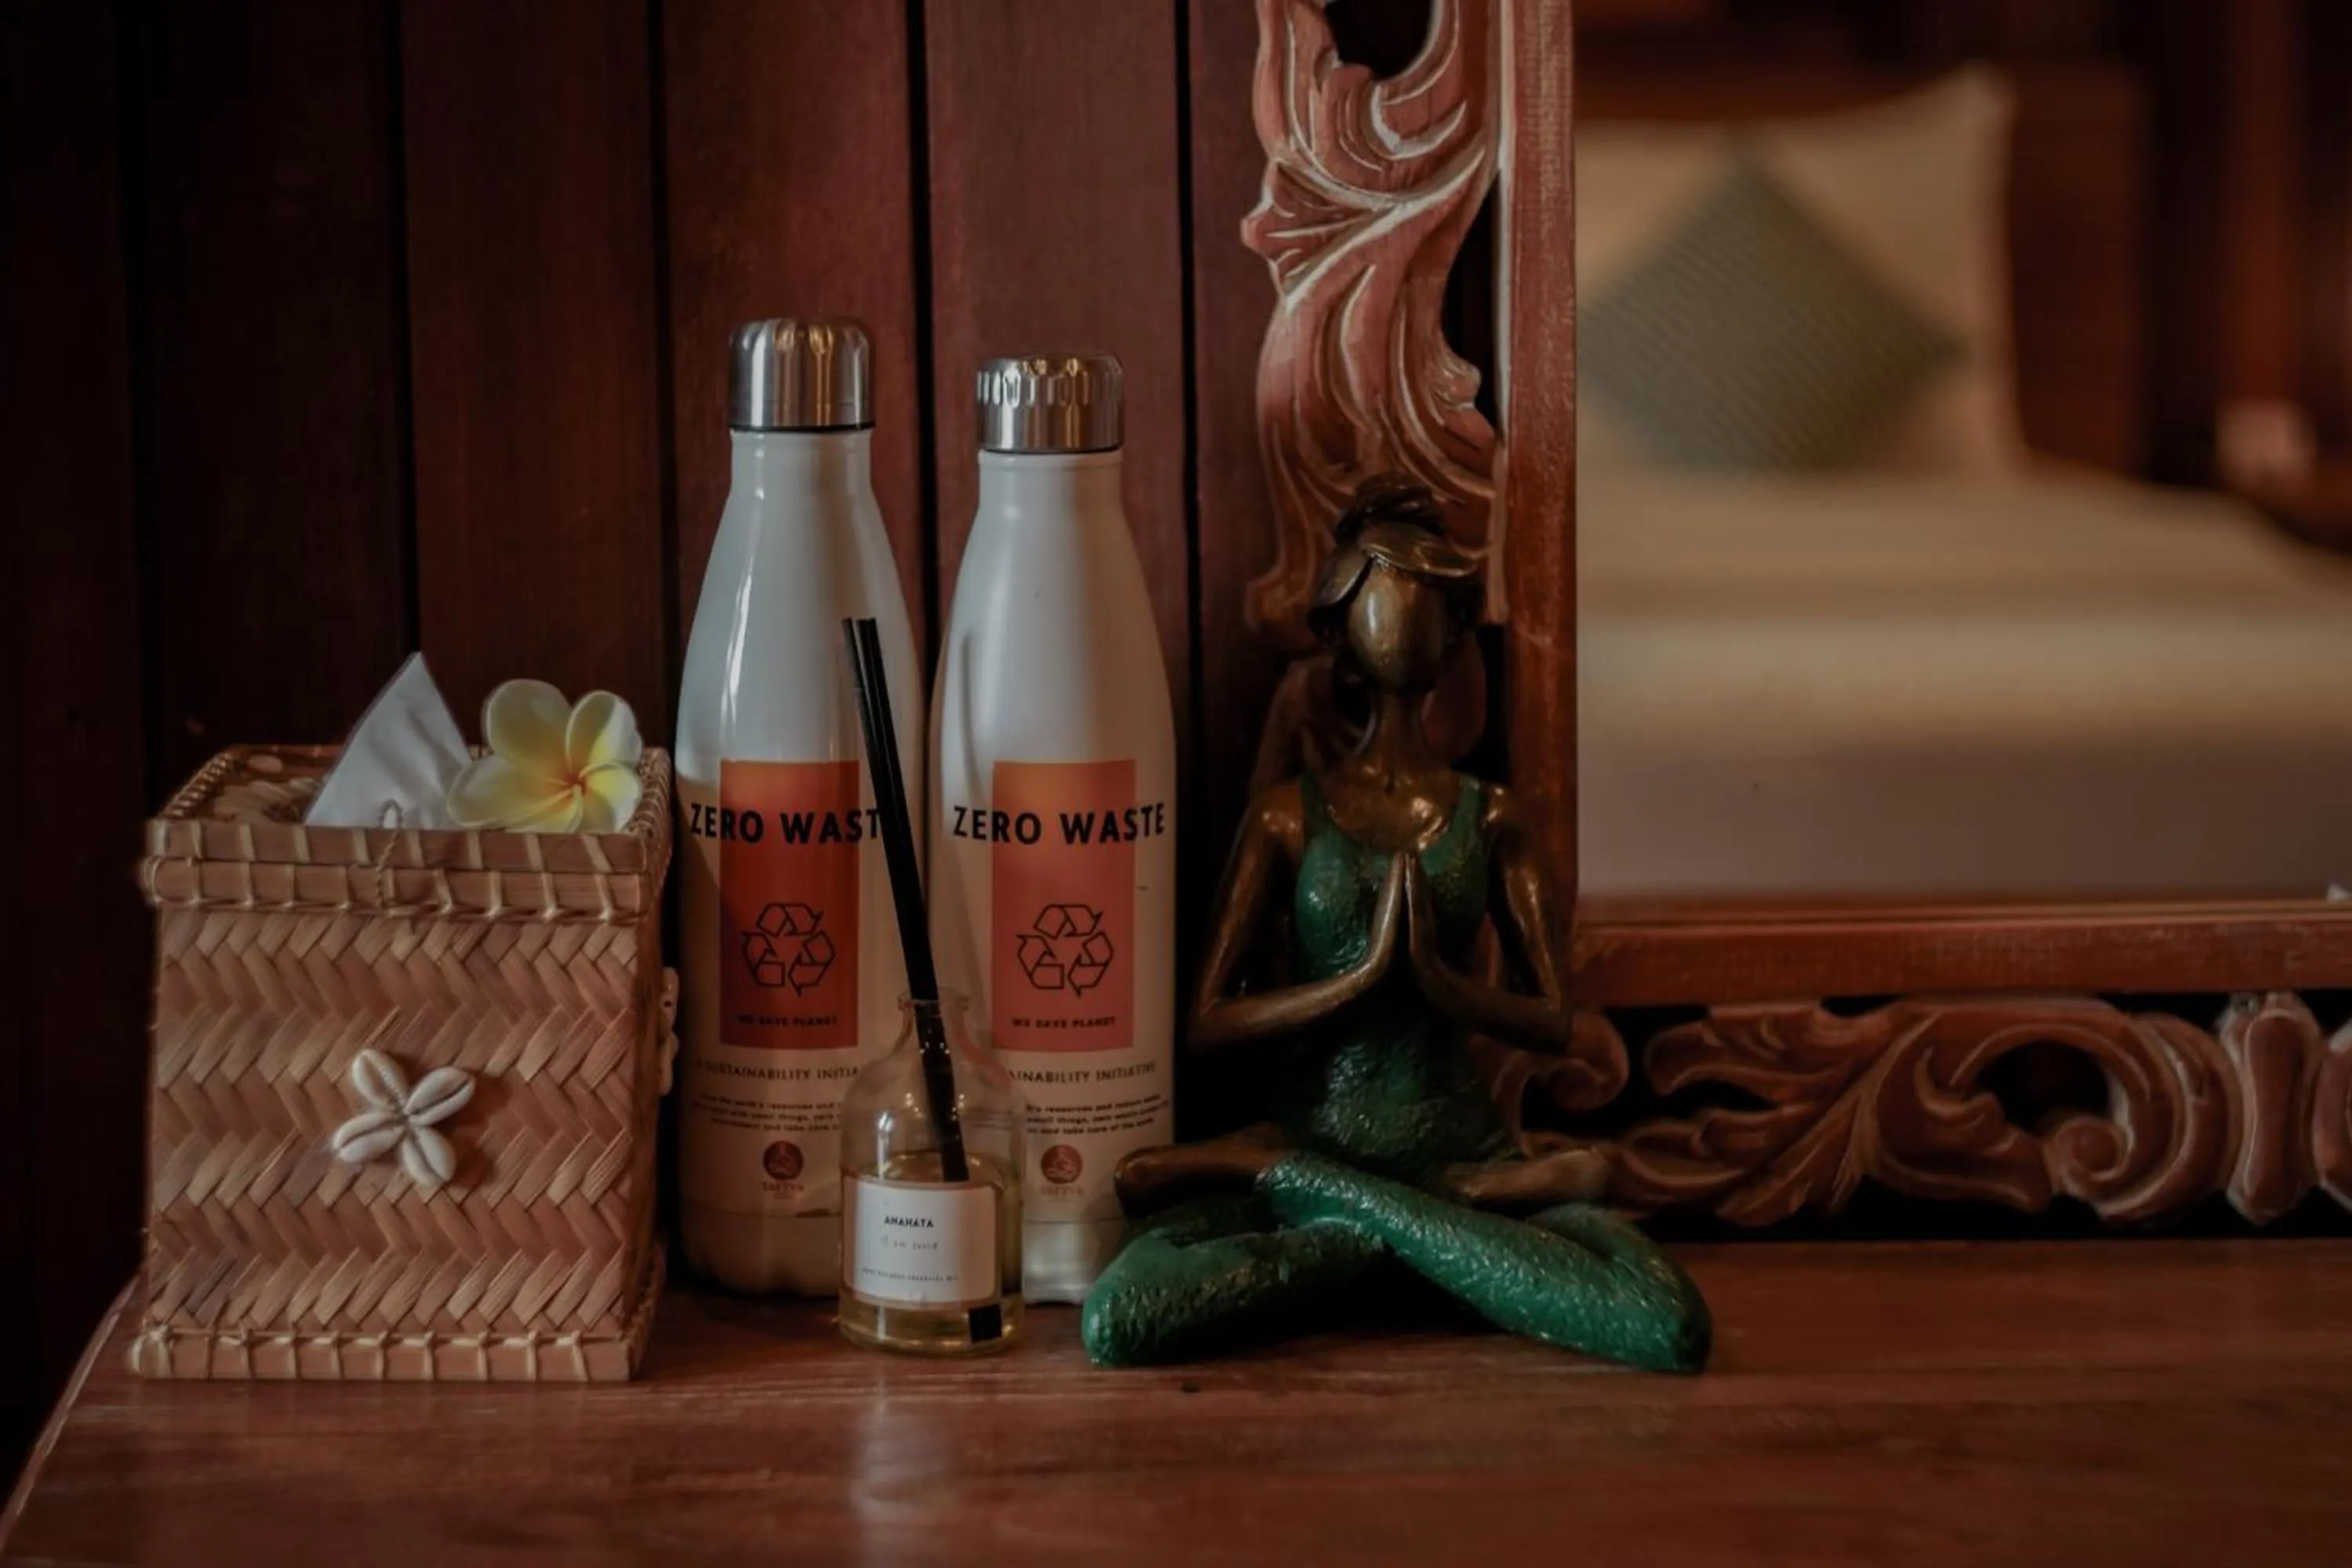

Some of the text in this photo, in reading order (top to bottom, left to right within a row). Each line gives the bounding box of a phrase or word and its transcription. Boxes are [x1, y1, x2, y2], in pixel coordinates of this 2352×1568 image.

[690, 803, 880, 844] ZERO WAST
[953, 803, 1164, 844] ZERO WASTE
[817, 1065, 859, 1080] INITIA
[884, 1216, 934, 1229] ANAHATA
